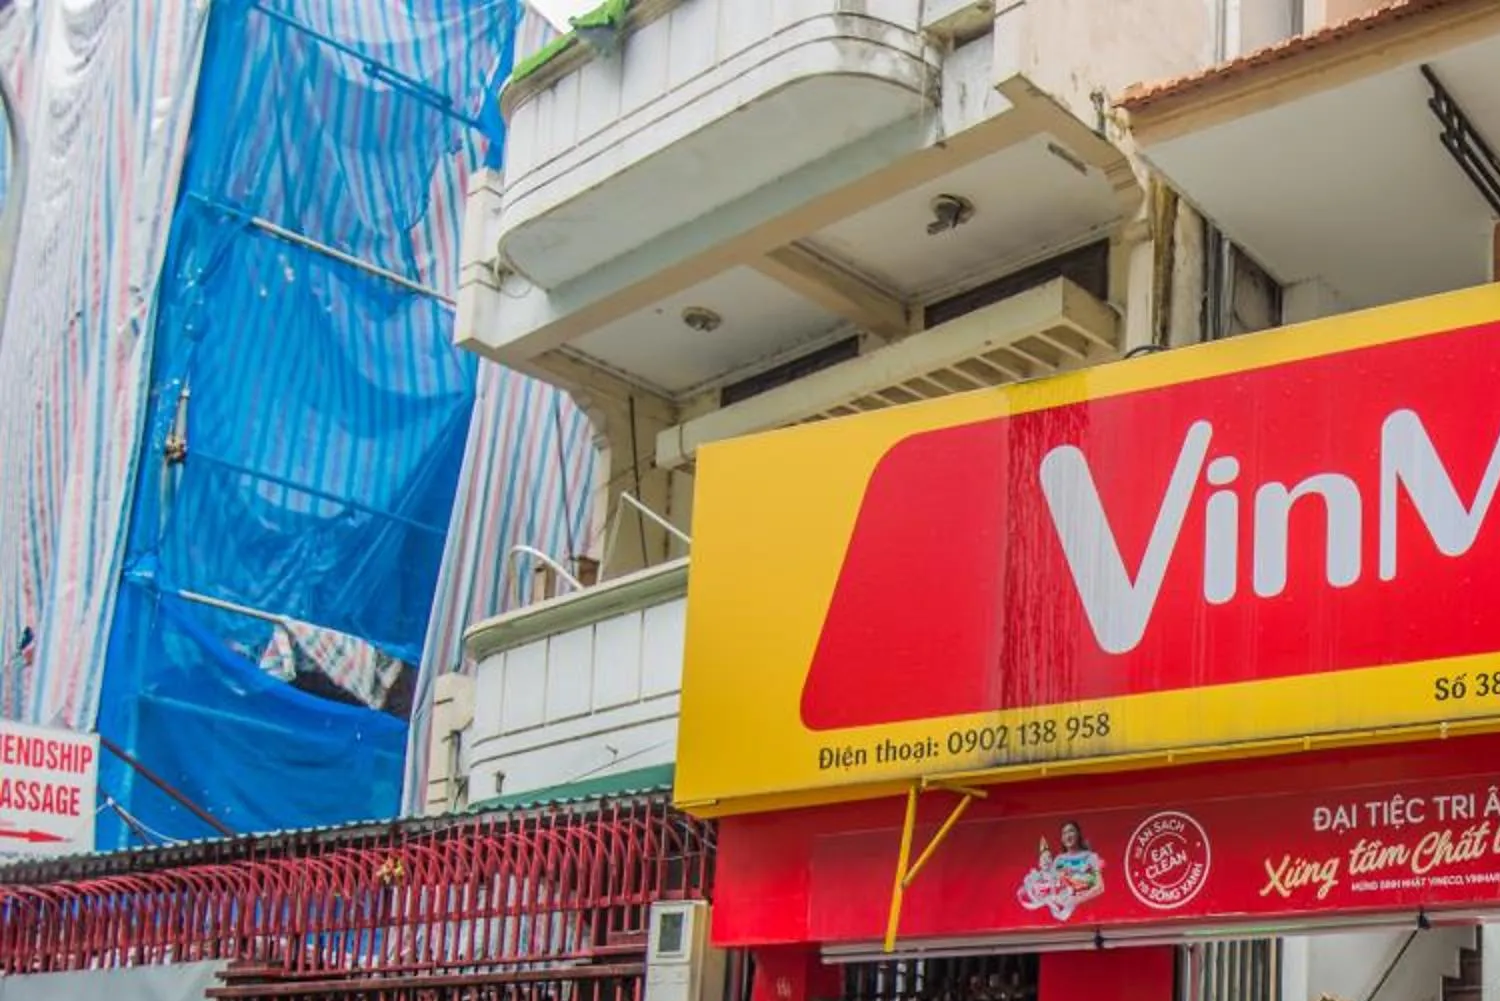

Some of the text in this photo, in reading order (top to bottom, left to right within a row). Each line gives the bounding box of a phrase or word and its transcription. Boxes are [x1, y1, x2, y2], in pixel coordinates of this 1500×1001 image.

[1434, 671, 1468, 701] Số
[819, 712, 1111, 772] Điện thoại: 0902 138 958
[0, 778, 80, 816] ASSAGE
[1312, 803, 1357, 834] ĐẠI
[1364, 793, 1425, 829] TIỆC
[1432, 792, 1475, 821] TRI
[1145, 849, 1188, 880] CLEAN
[1151, 841, 1175, 863] EAT
[1258, 853, 1341, 900] Xứng
